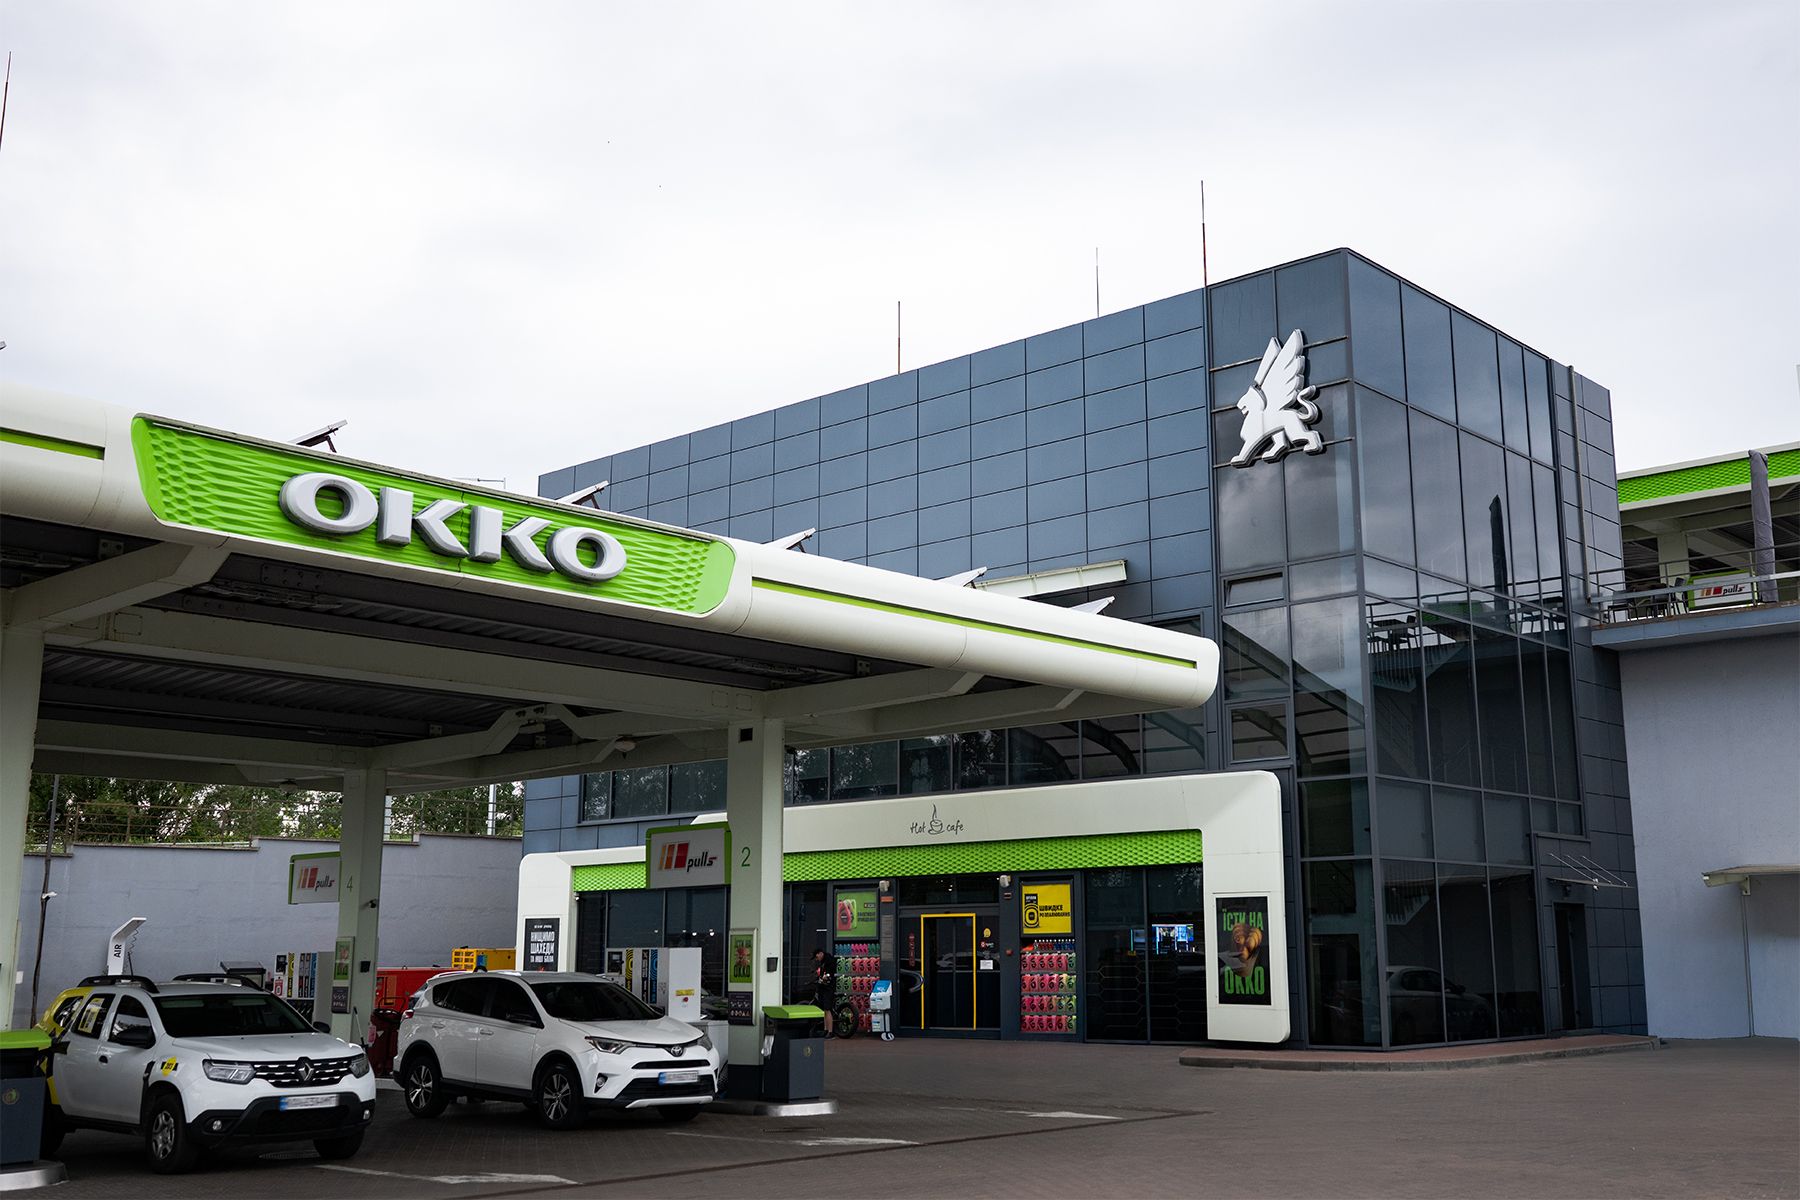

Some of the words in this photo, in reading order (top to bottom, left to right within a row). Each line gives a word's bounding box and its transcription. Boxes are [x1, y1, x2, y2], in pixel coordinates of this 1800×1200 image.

[279, 472, 627, 583] OKKO
[1723, 583, 1745, 595] pulls
[910, 821, 926, 834] Hot
[946, 819, 964, 835] cafe
[686, 851, 718, 872] pulls
[741, 846, 751, 867] 2
[315, 874, 335, 892] pulls
[346, 875, 353, 892] 4
[1248, 911, 1265, 931] НА
[113, 944, 123, 958] AIR
[530, 942, 555, 955] ШАХЕДИ
